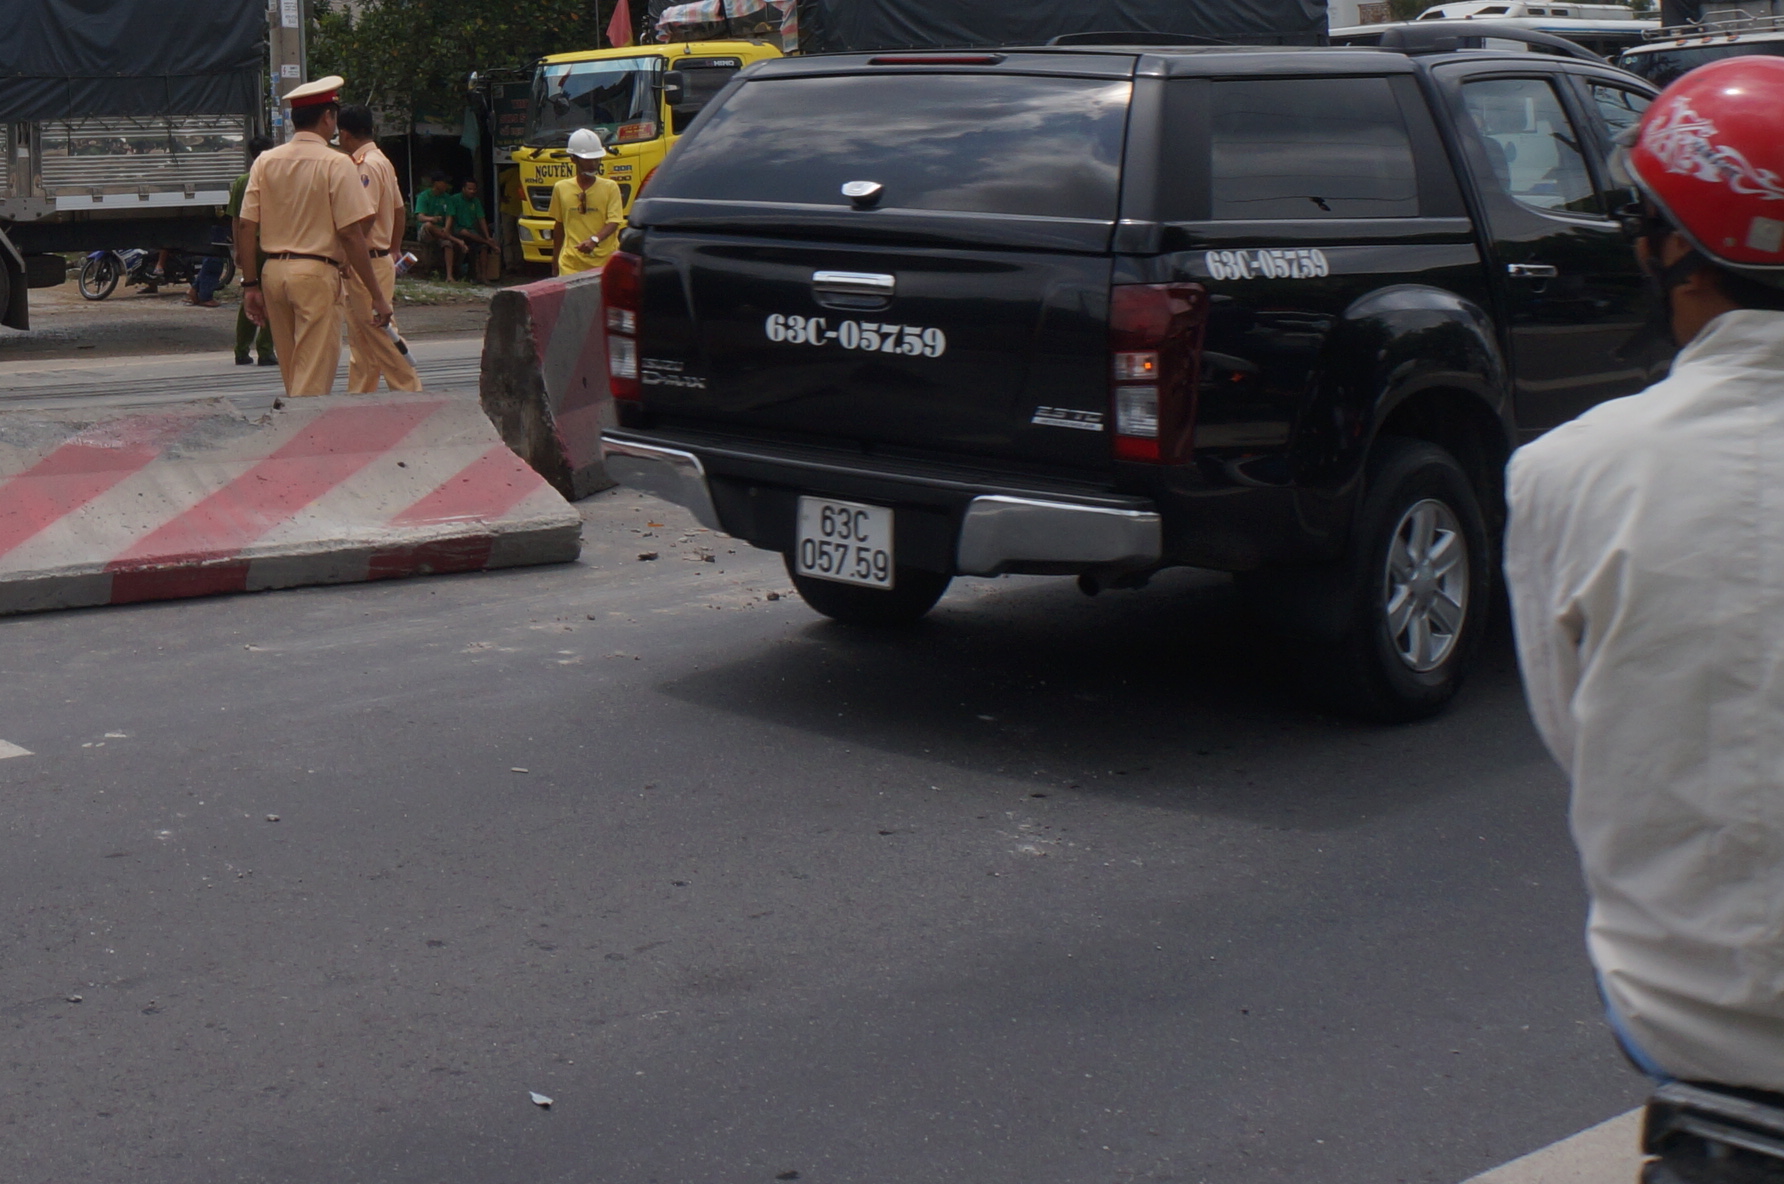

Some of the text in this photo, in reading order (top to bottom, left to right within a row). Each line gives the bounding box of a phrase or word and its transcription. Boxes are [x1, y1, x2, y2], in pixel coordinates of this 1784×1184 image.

[765, 313, 947, 358] 63C-057.59
[820, 504, 869, 544] 63C
[801, 537, 890, 583] 057.59
